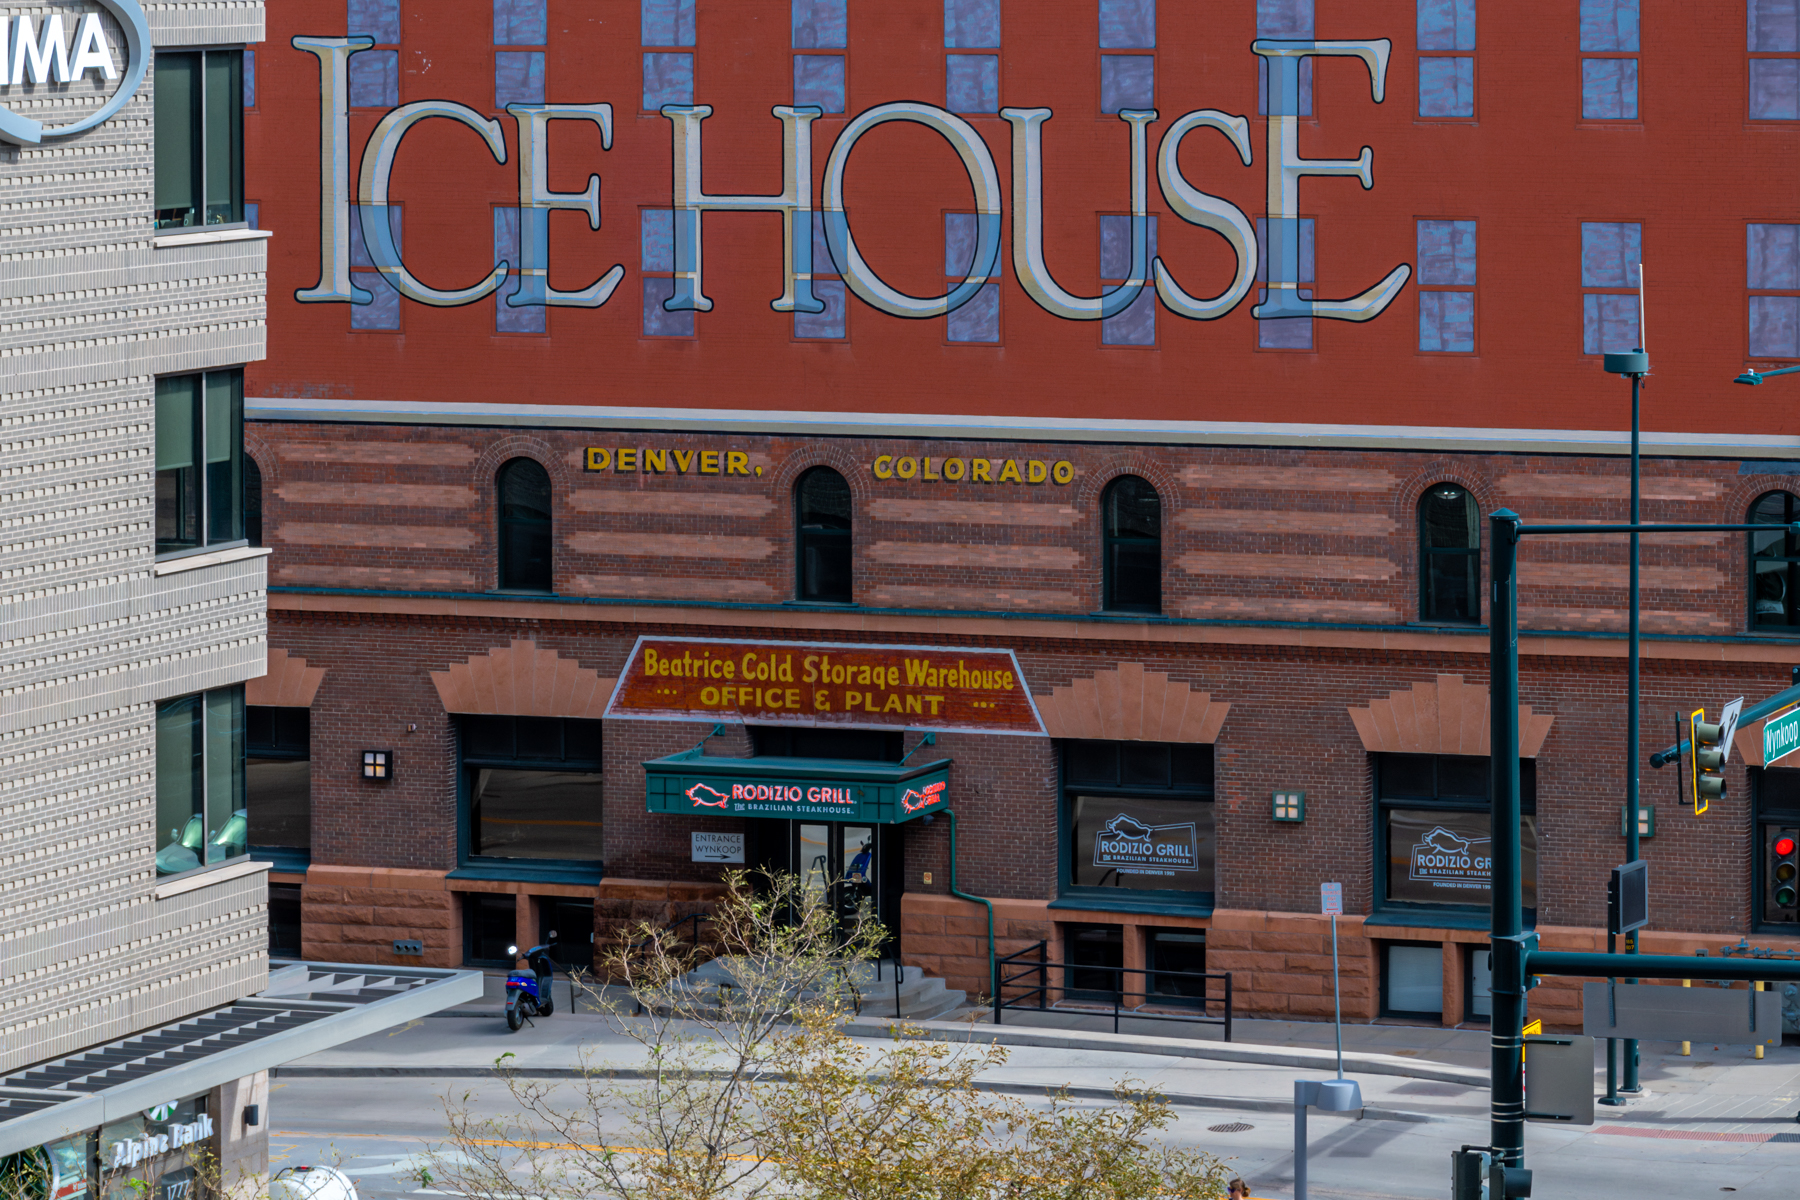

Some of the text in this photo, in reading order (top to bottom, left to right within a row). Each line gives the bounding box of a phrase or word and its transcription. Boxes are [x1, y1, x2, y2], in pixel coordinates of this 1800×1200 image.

[291, 34, 1413, 322] ICE HOUSE
[870, 454, 1077, 486] COLORADO
[644, 648, 735, 679] Beatrice
[741, 652, 794, 682] Cold
[904, 658, 1014, 691] Warehouse
[700, 686, 945, 715] OFFICE & PLANT
[1766, 720, 1799, 759] Wynkoop
[732, 784, 855, 805] RODIZIO GRILL
[748, 803, 793, 812] BRAZILIAN
[796, 805, 851, 814] STEAKHOUSE
[695, 834, 741, 844] ENTRANCE
[695, 845, 742, 854] WYNKOOP
[1101, 841, 1191, 857] RODIZIO GRILL
[1417, 854, 1471, 869] RODIZIO
[112, 1113, 214, 1168] Alpine Bank
[166, 1179, 190, 1200] 1777
